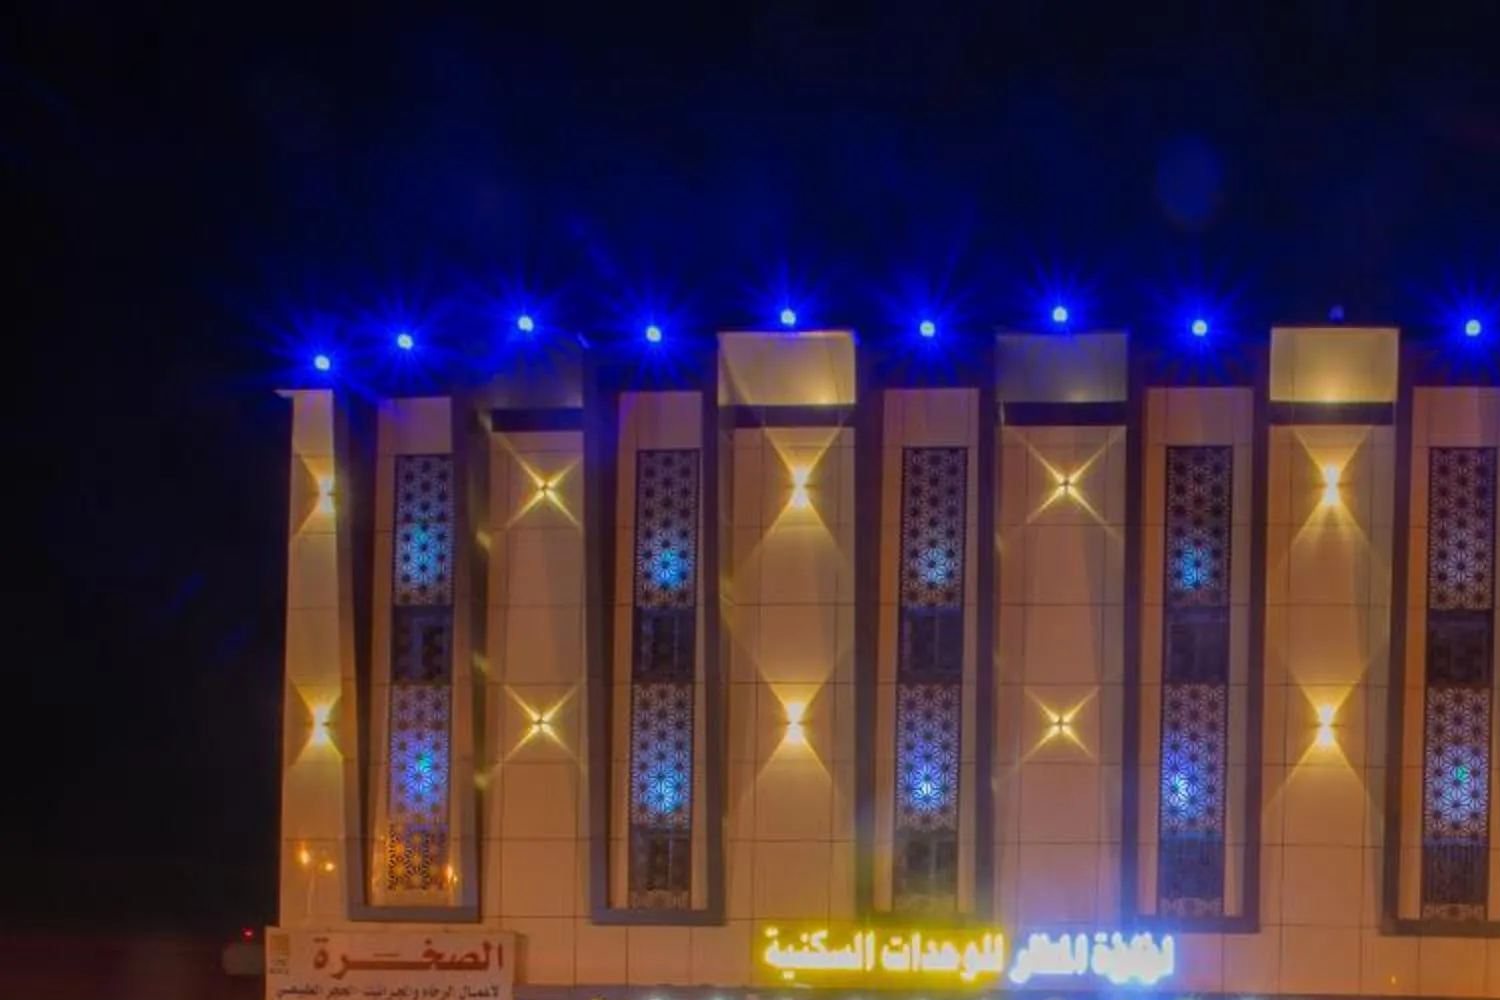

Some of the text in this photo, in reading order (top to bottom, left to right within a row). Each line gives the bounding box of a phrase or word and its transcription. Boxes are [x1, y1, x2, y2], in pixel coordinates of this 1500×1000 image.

[313, 936, 503, 980] الصخرة
[763, 927, 876, 980] السكنية
[881, 930, 1005, 982] للوحدات
